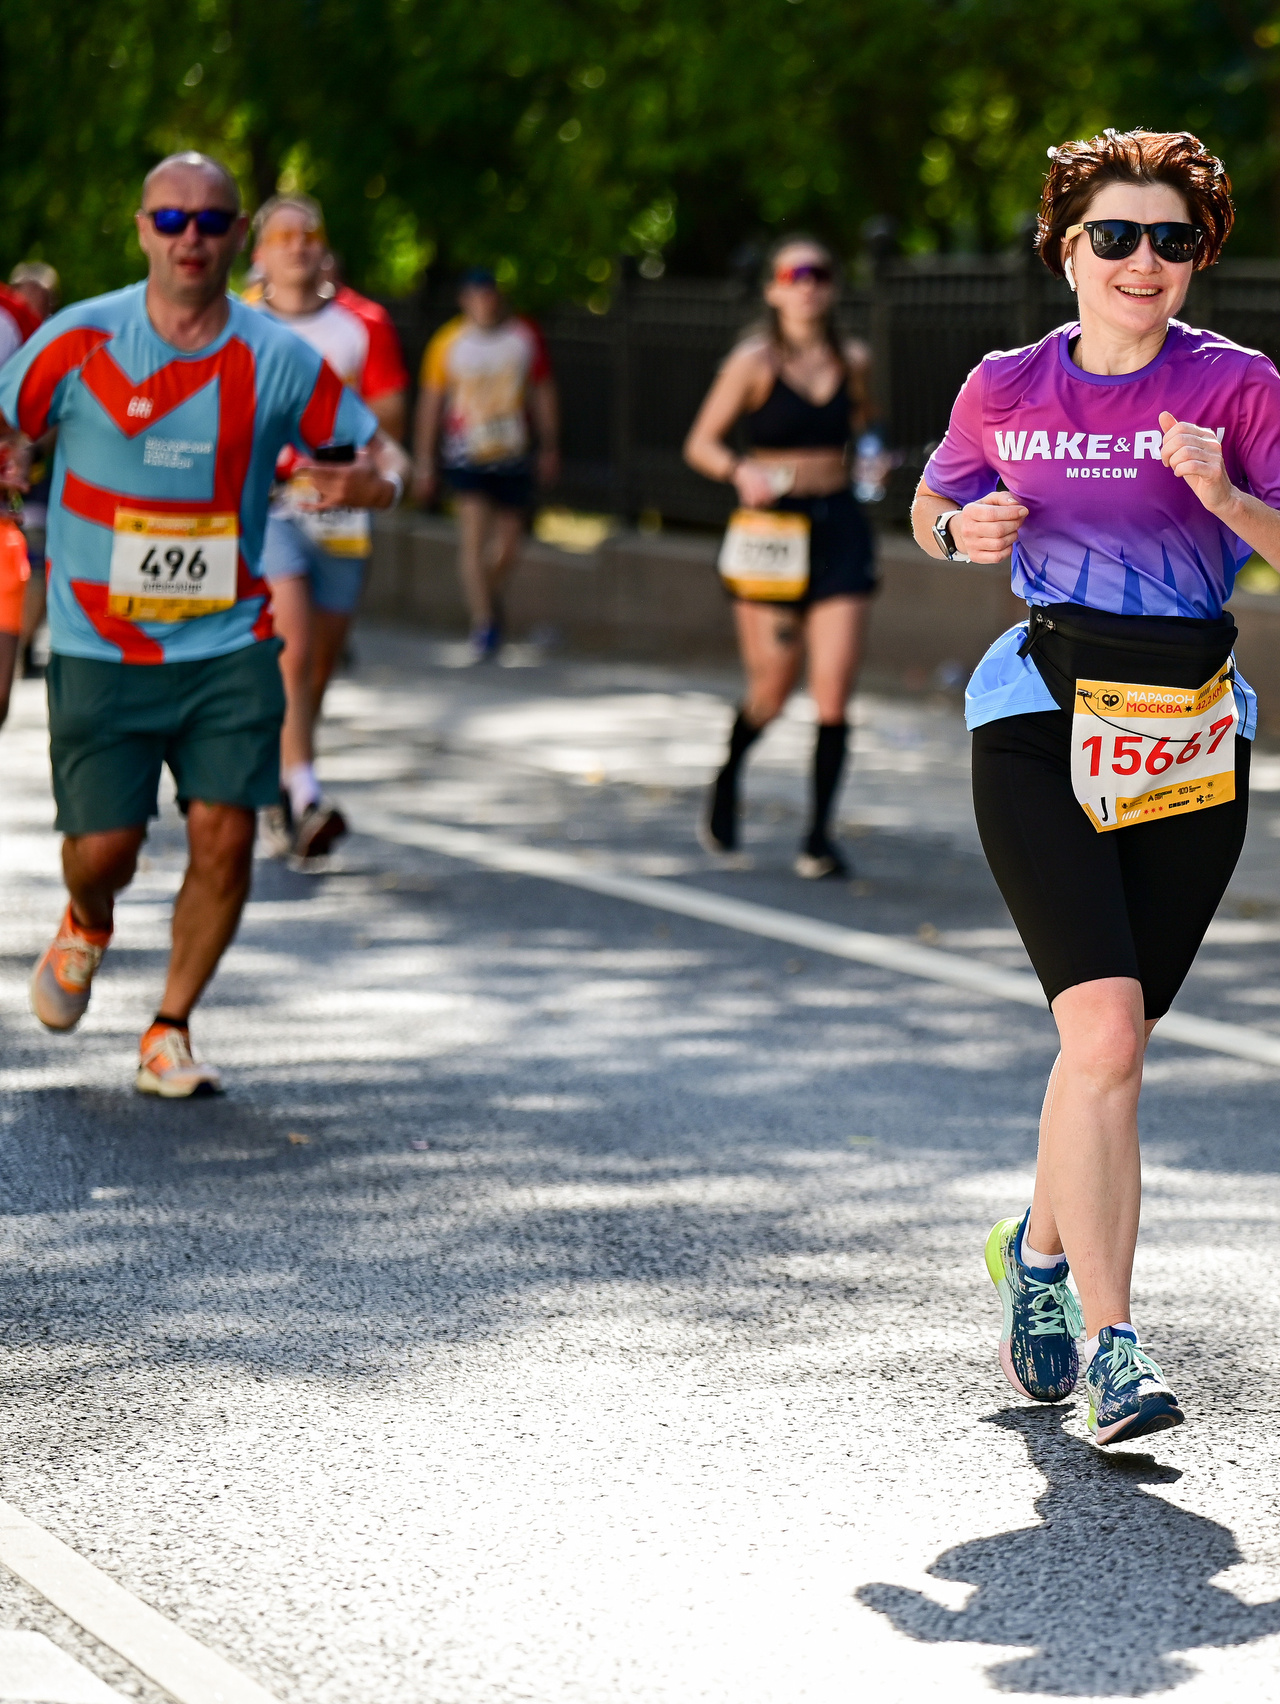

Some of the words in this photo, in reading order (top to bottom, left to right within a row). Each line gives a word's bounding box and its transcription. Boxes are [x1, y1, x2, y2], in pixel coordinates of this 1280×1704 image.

[1066, 467, 1138, 478] MOSCOW
[140, 547, 207, 580] 496
[1126, 690, 1195, 704] МАРАФОН
[1195, 695, 1212, 711] 42,2
[1126, 702, 1182, 714] МОСКВА
[1082, 715, 1234, 776] 15667
